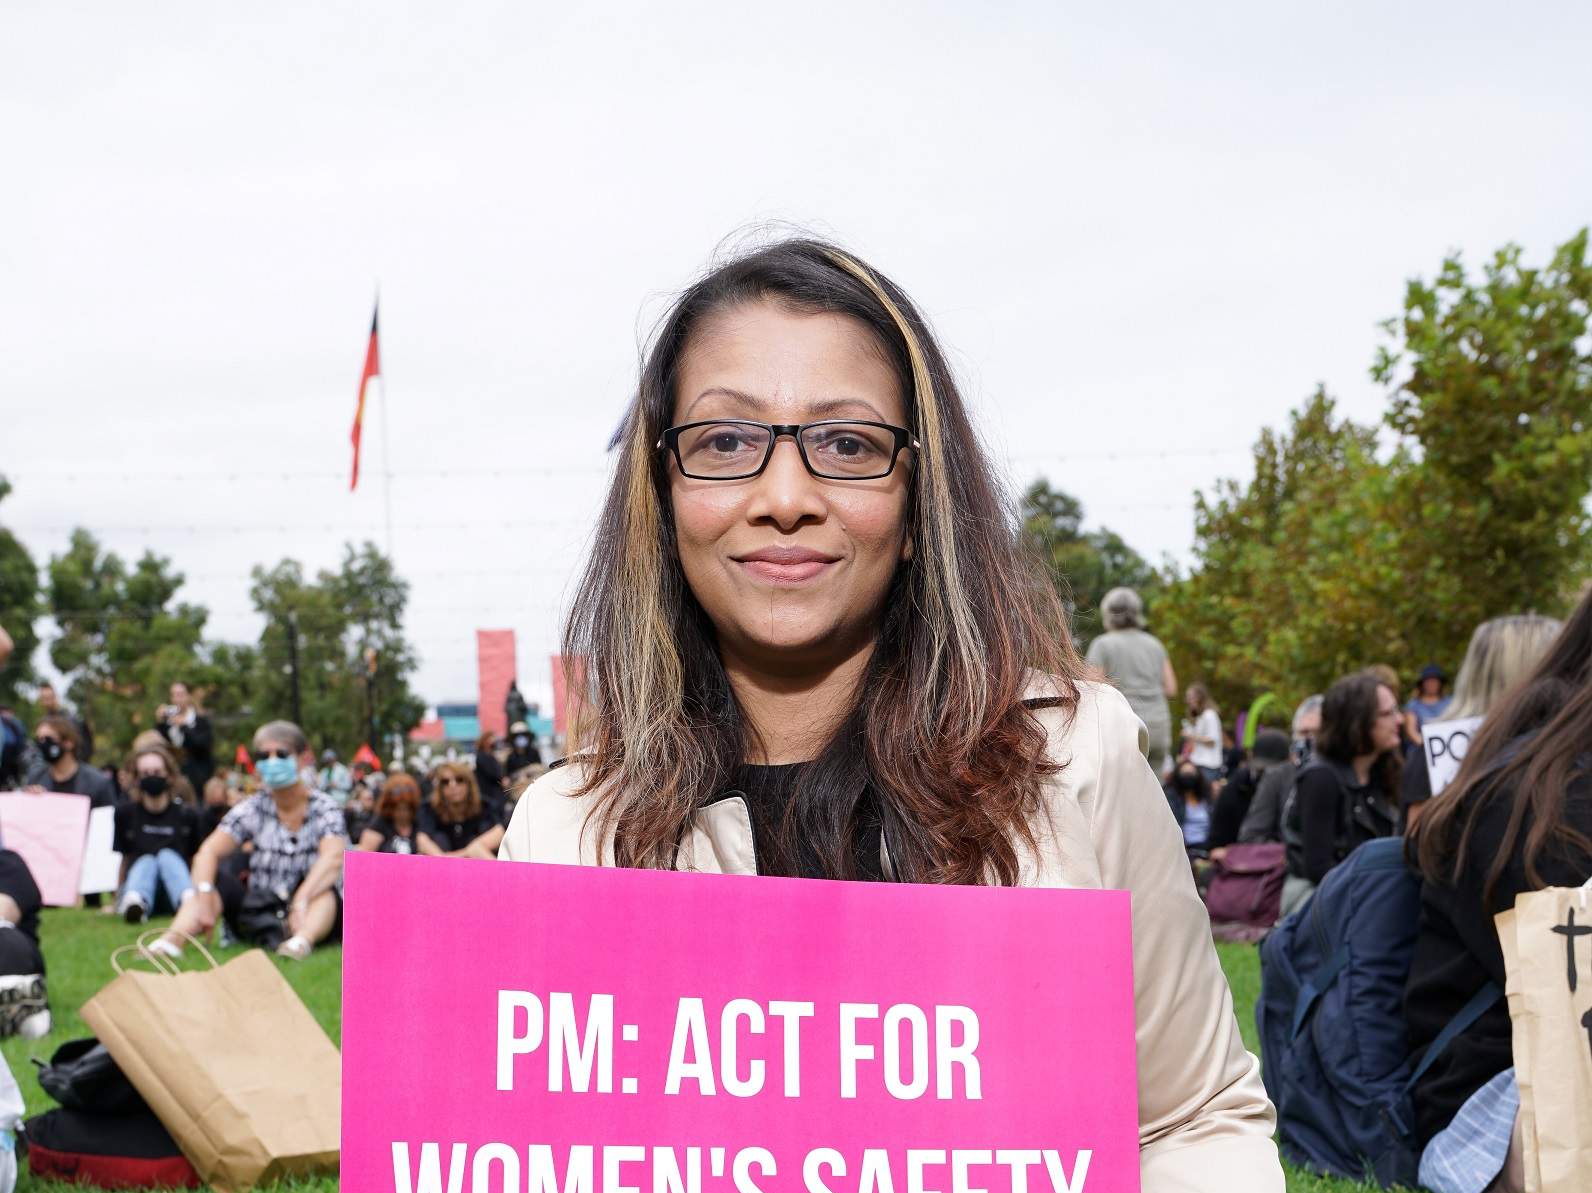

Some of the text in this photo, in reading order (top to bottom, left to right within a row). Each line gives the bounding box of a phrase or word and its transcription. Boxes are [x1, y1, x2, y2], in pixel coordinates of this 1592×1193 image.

[1428, 731, 1471, 768] PO
[496, 989, 983, 1100] PM: ACT FOR
